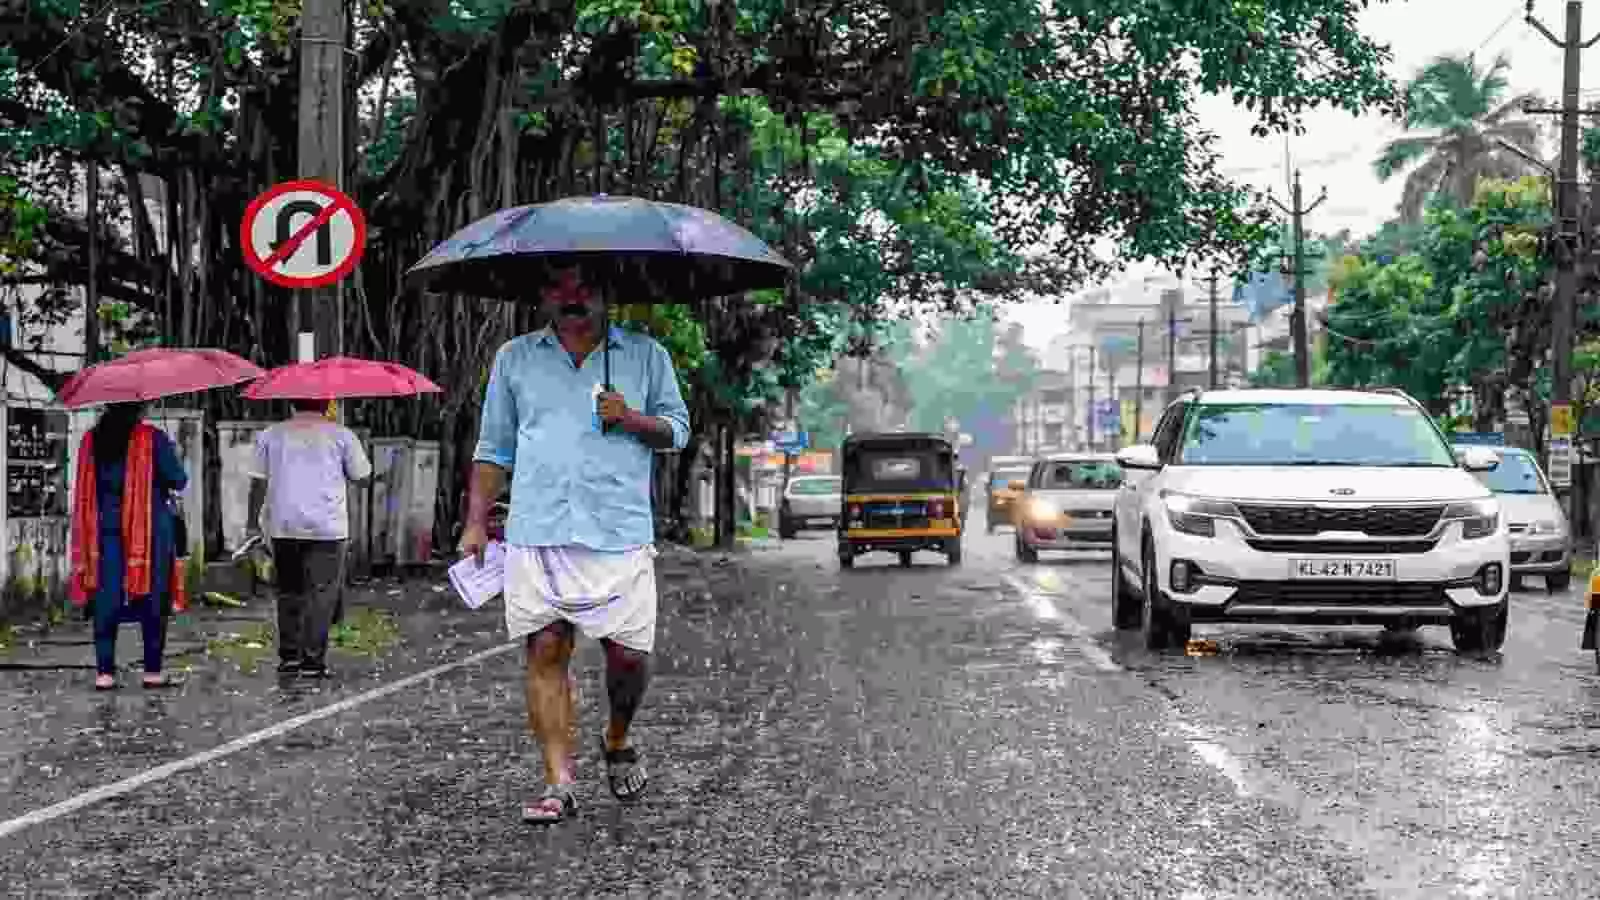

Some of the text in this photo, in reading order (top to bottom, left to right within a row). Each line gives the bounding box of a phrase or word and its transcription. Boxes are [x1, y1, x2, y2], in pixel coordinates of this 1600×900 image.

[1299, 562, 1320, 577] KL
[1321, 562, 1338, 577] 42
[1355, 562, 1392, 577] 7421
